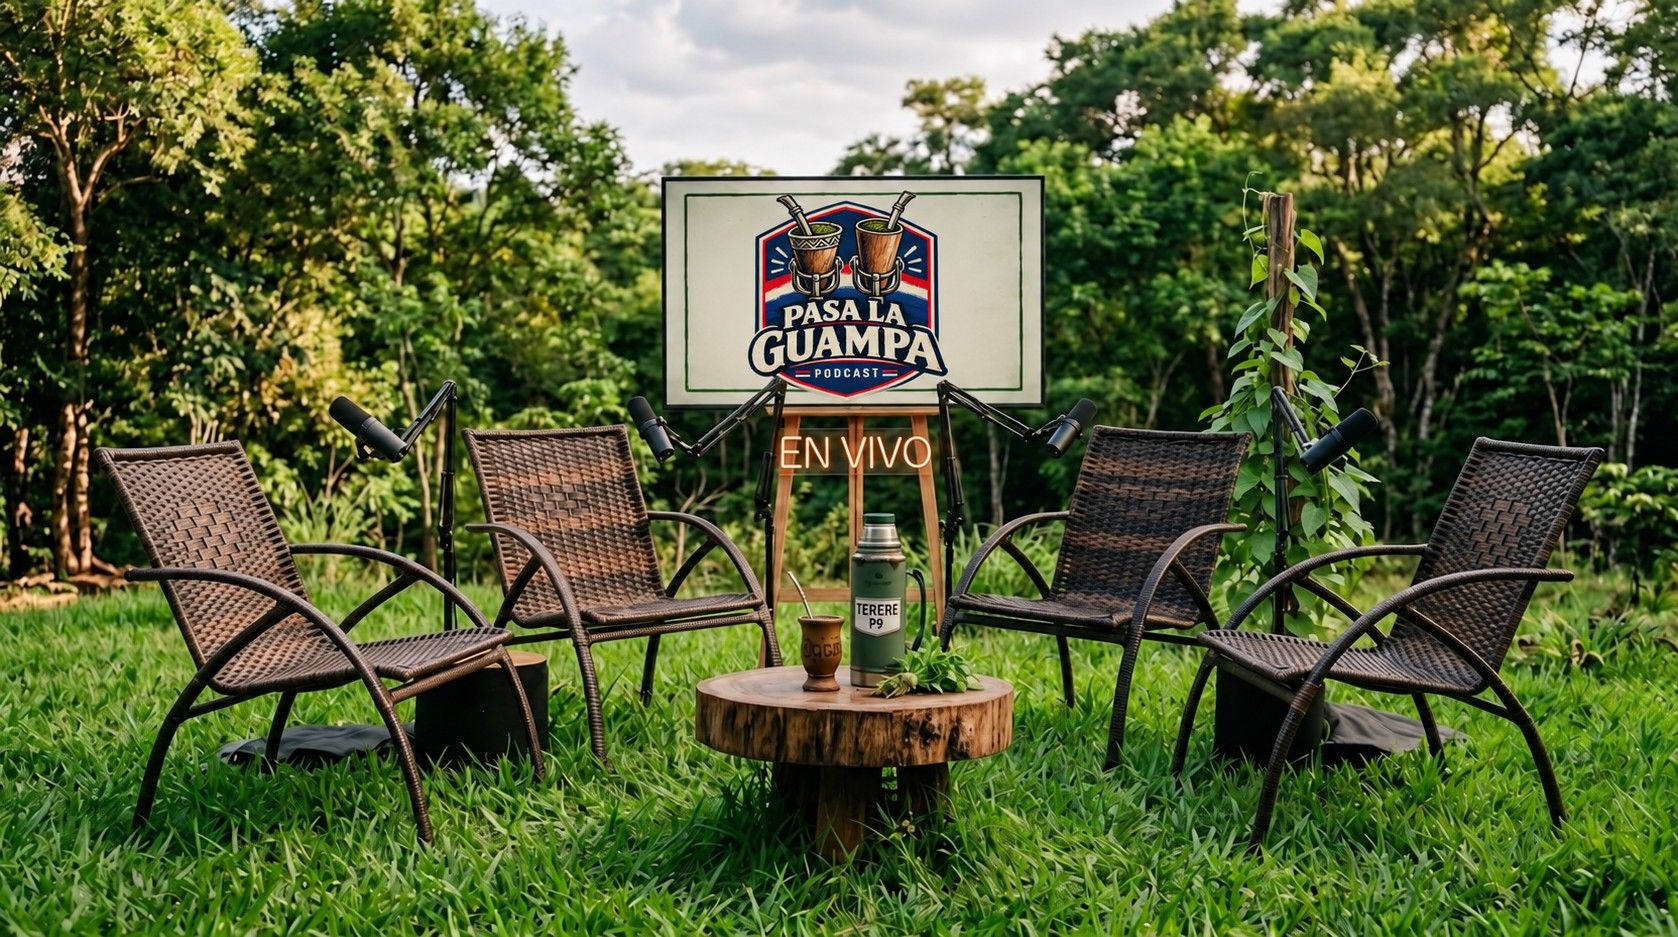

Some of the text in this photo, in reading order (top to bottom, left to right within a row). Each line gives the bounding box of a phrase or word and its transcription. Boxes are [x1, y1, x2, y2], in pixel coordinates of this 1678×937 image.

[783, 299, 908, 329] PASA LA
[751, 324, 943, 374] GUAMPA
[814, 367, 879, 379] PODCAST
[780, 435, 932, 469] EN VIVO
[856, 602, 898, 617] TERERE
[869, 617, 884, 630] P9
